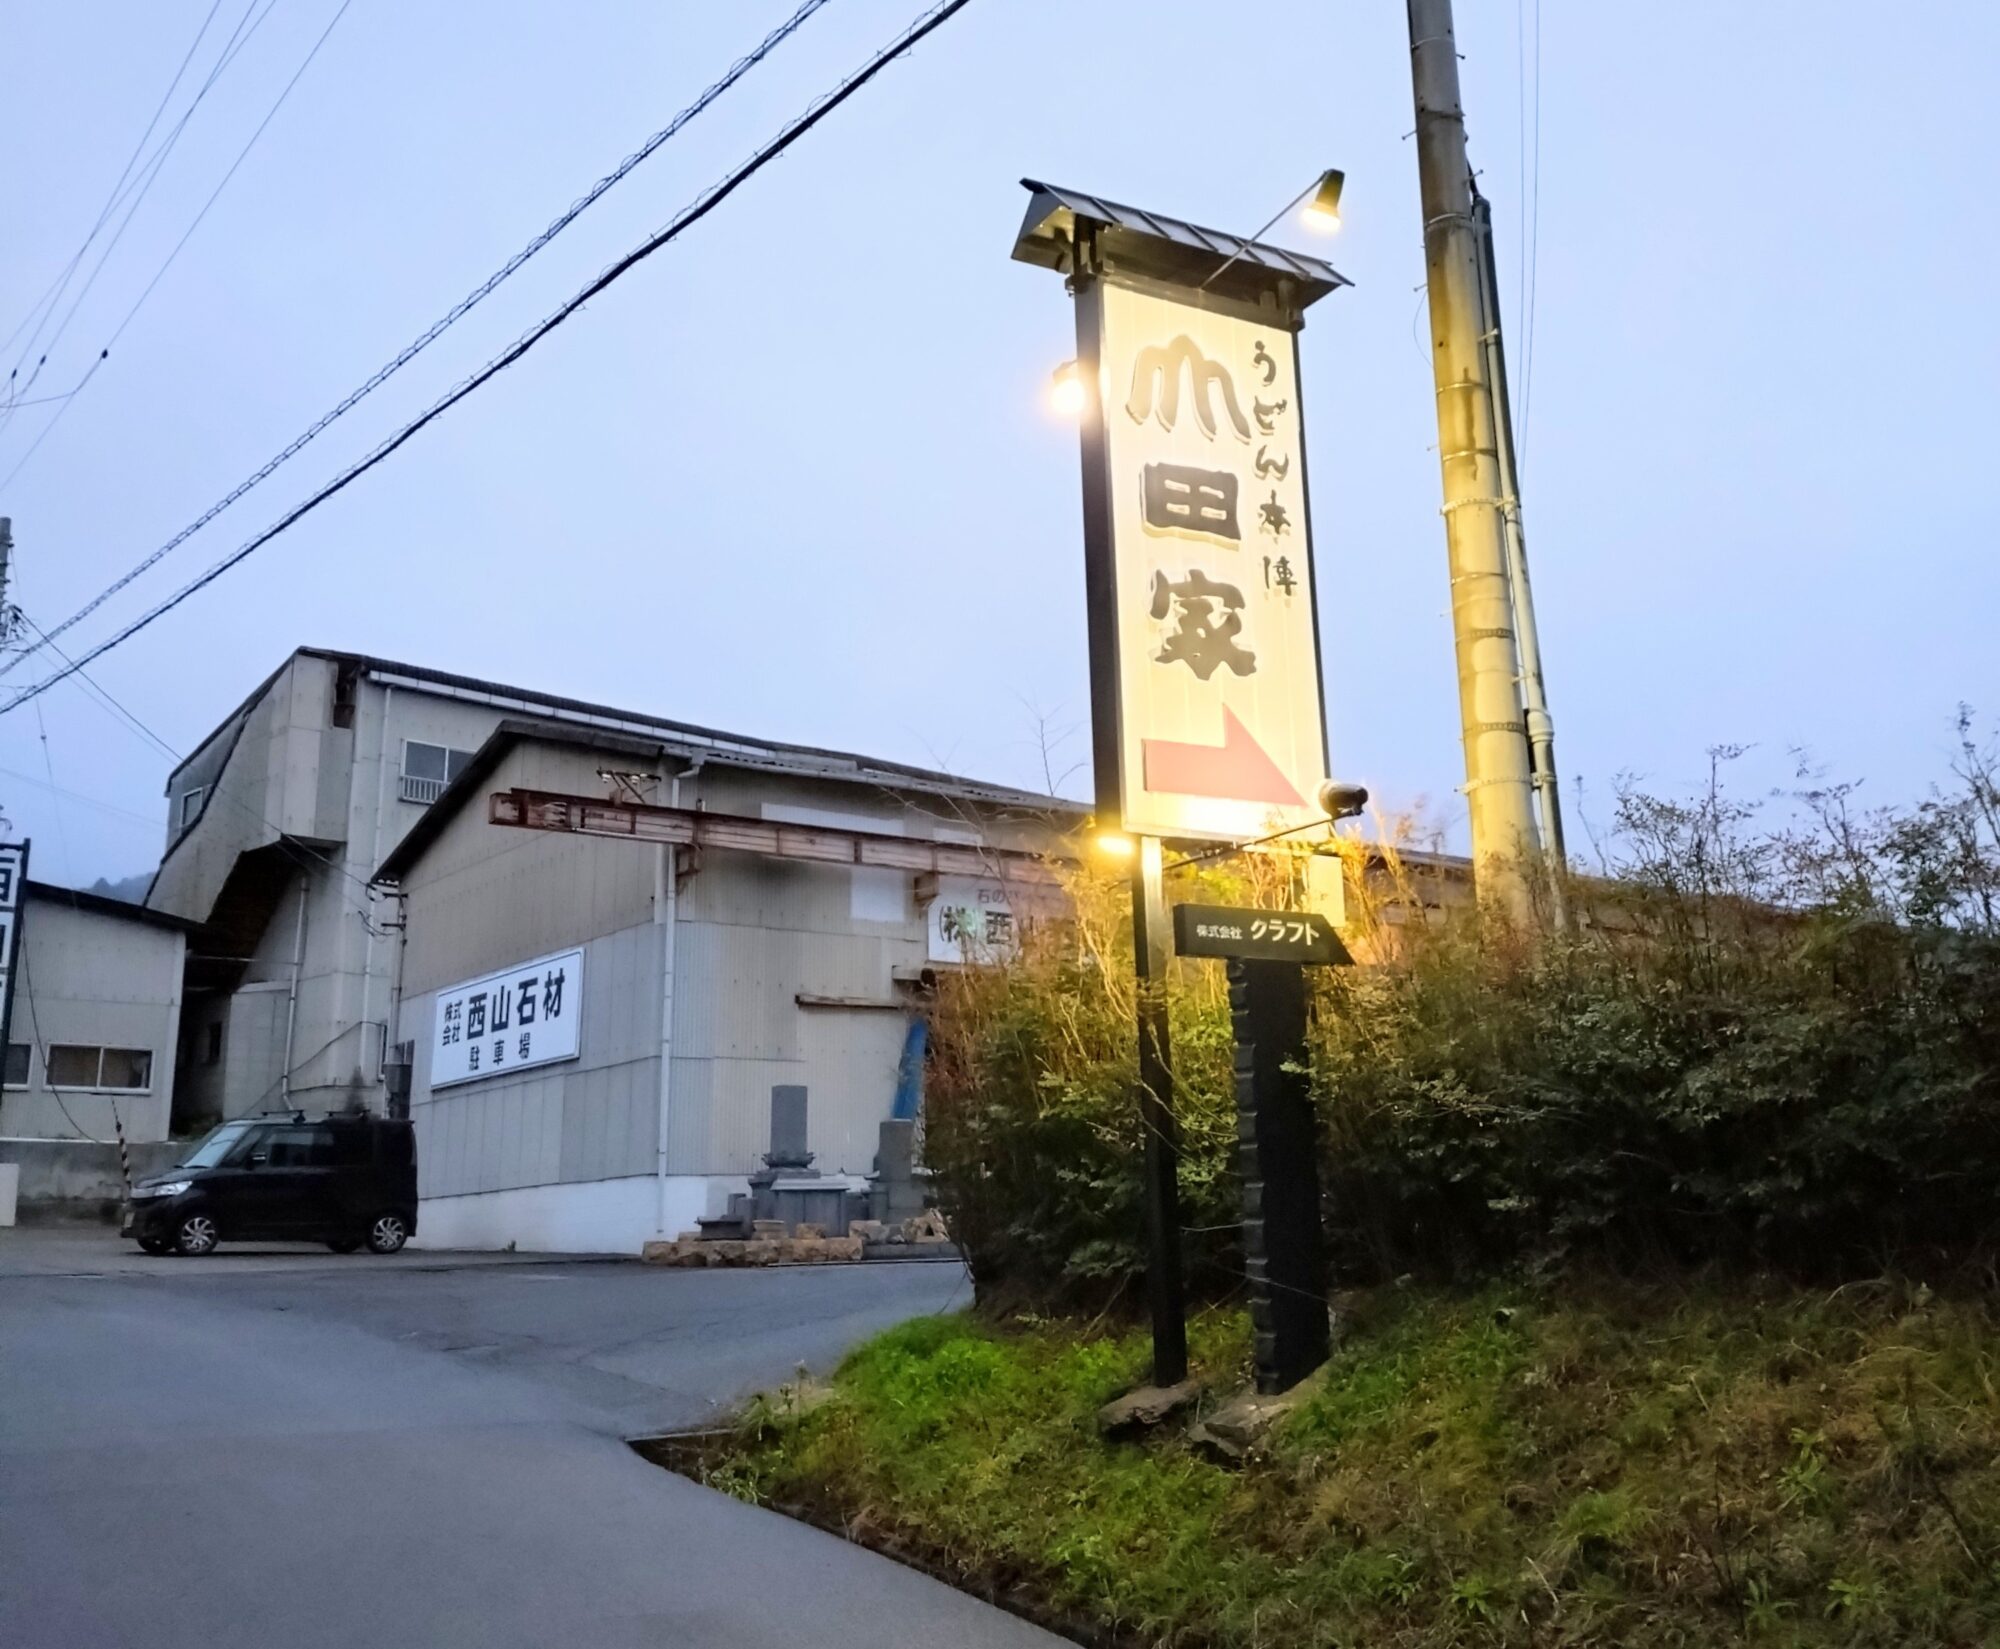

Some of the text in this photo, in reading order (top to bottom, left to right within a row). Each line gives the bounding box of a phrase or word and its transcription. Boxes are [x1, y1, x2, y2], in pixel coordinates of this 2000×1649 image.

[1196, 924, 1243, 940] 株式会社
[1250, 918, 1320, 946] クラフト
[466, 967, 566, 1041] 西山石材
[468, 1032, 531, 1072] 駐車場
